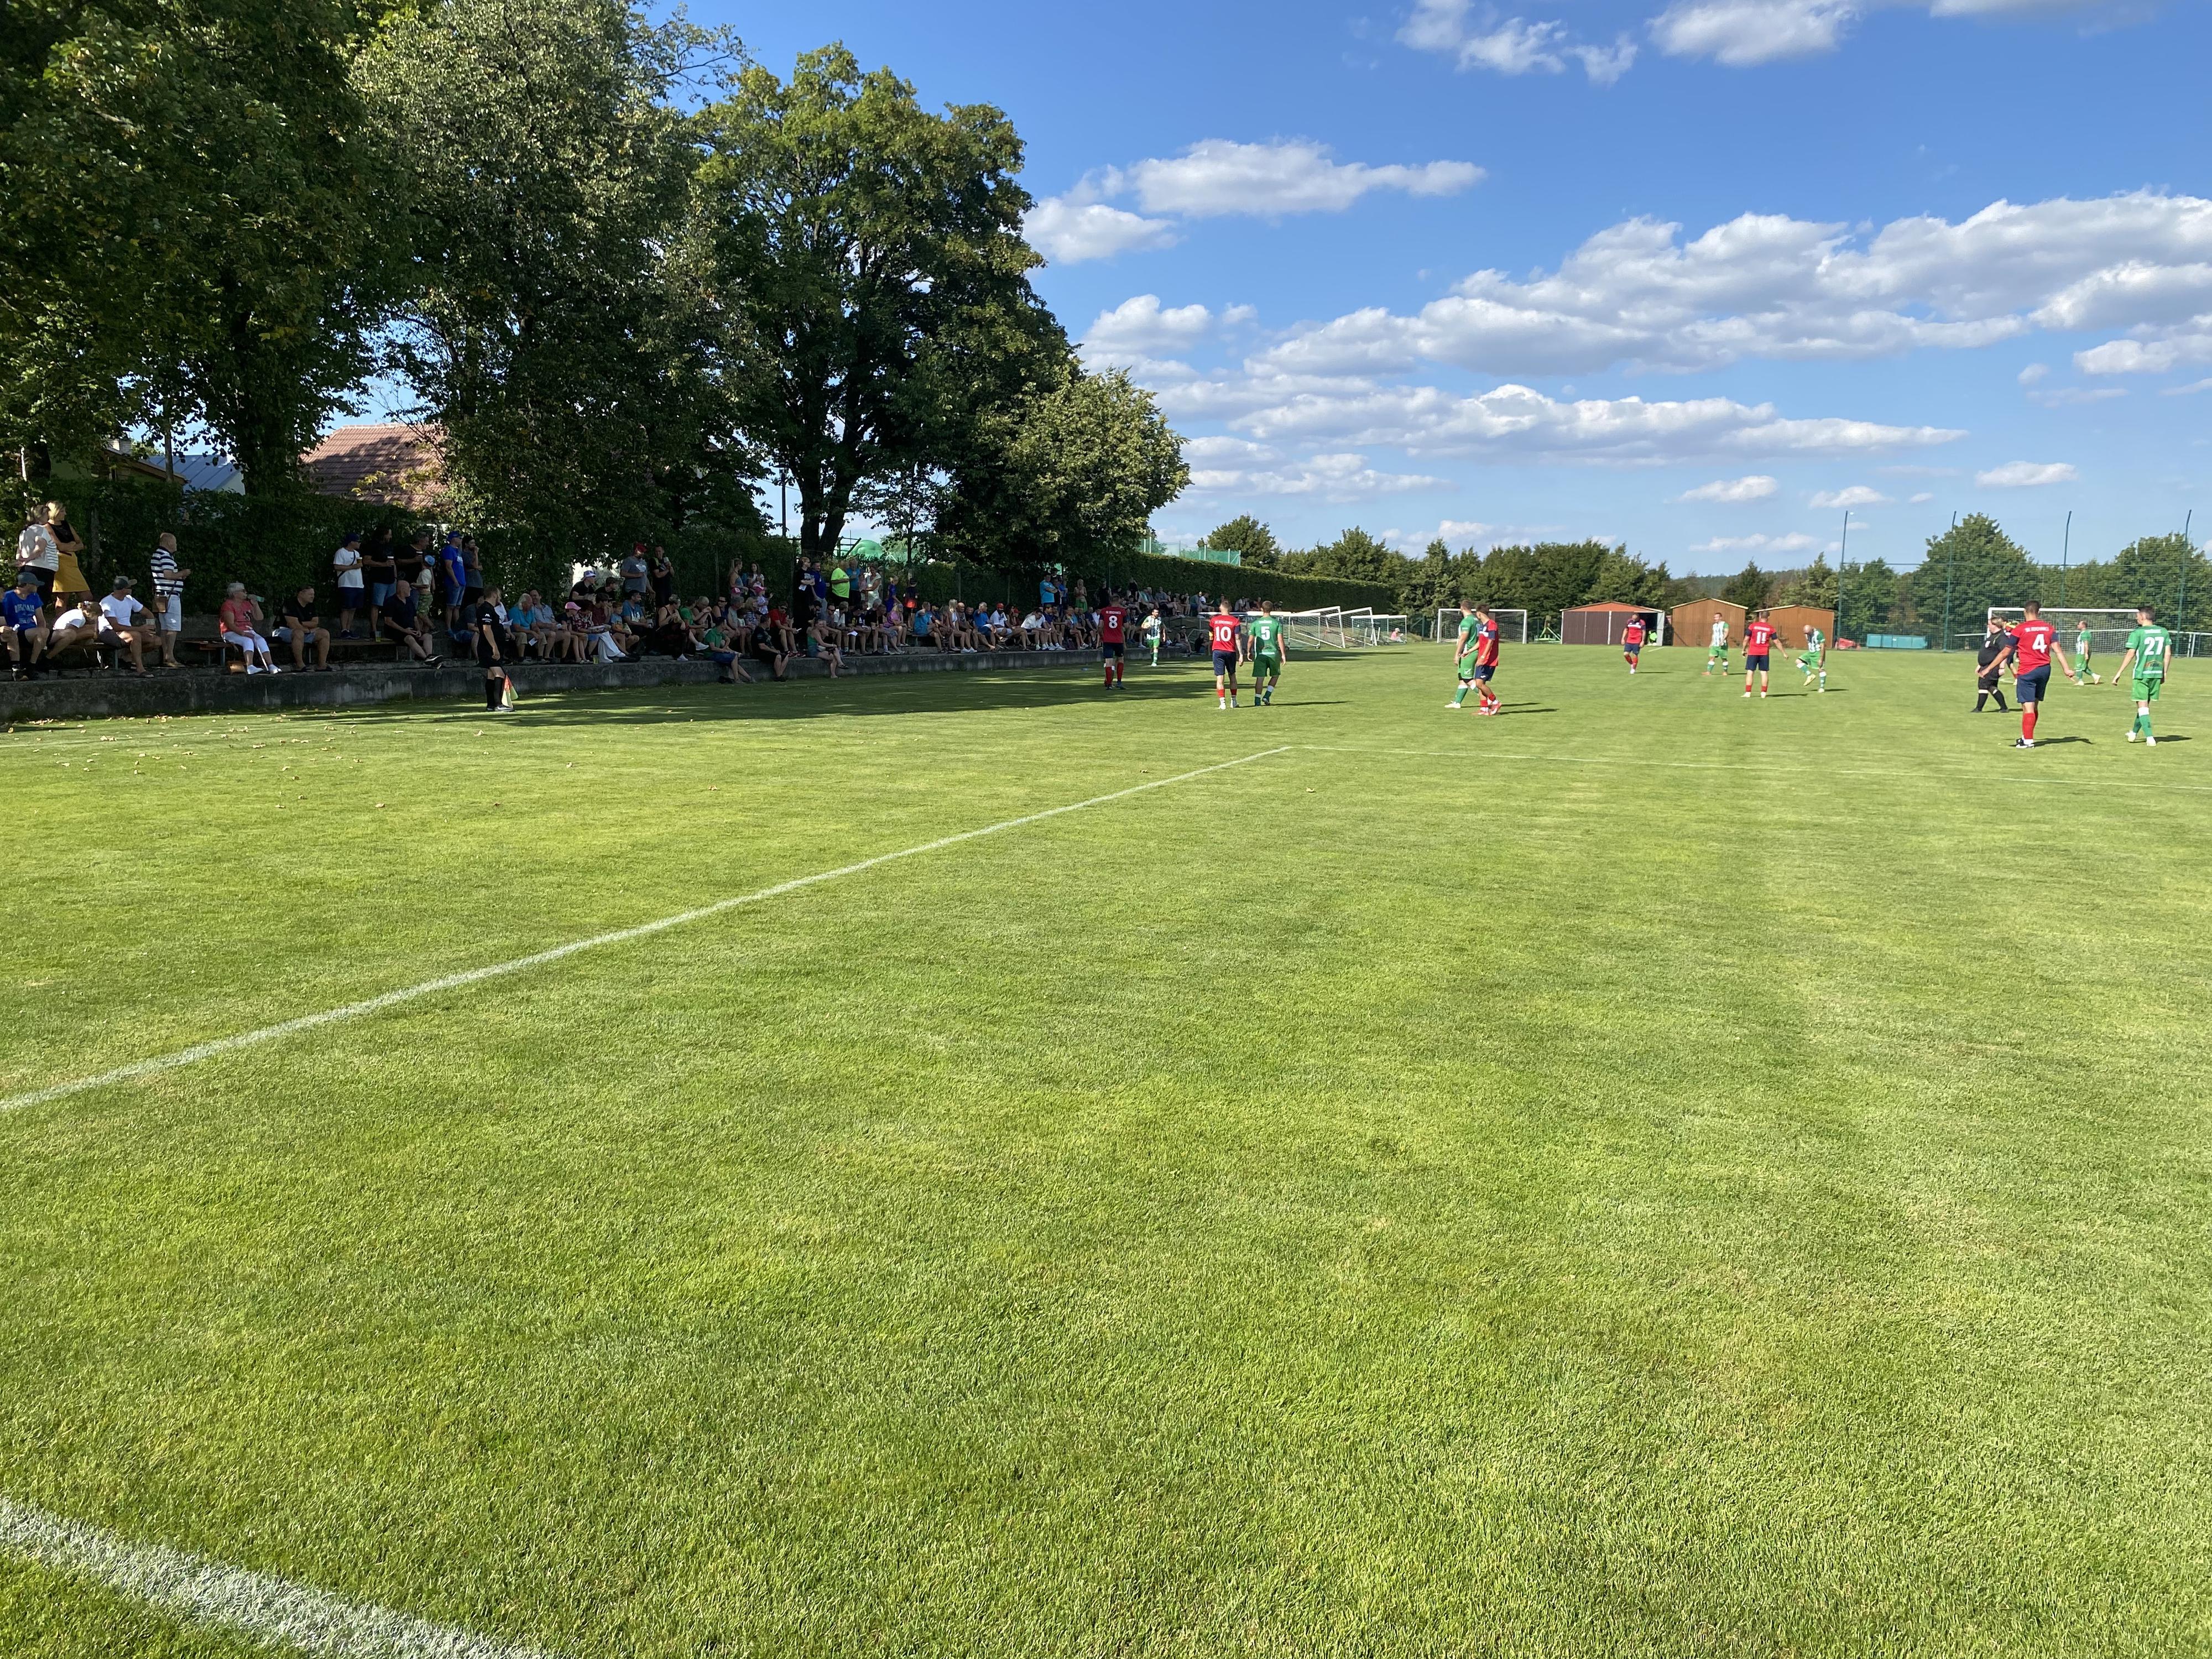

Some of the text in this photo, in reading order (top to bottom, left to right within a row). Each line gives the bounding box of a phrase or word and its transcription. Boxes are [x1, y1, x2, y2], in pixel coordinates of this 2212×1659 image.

[1109, 615, 1118, 629] 8
[1215, 626, 1232, 641] 10
[1261, 626, 1270, 640] 5
[1756, 632, 1767, 644] 11
[2032, 633, 2048, 653] 4
[2144, 637, 2164, 656] 27
